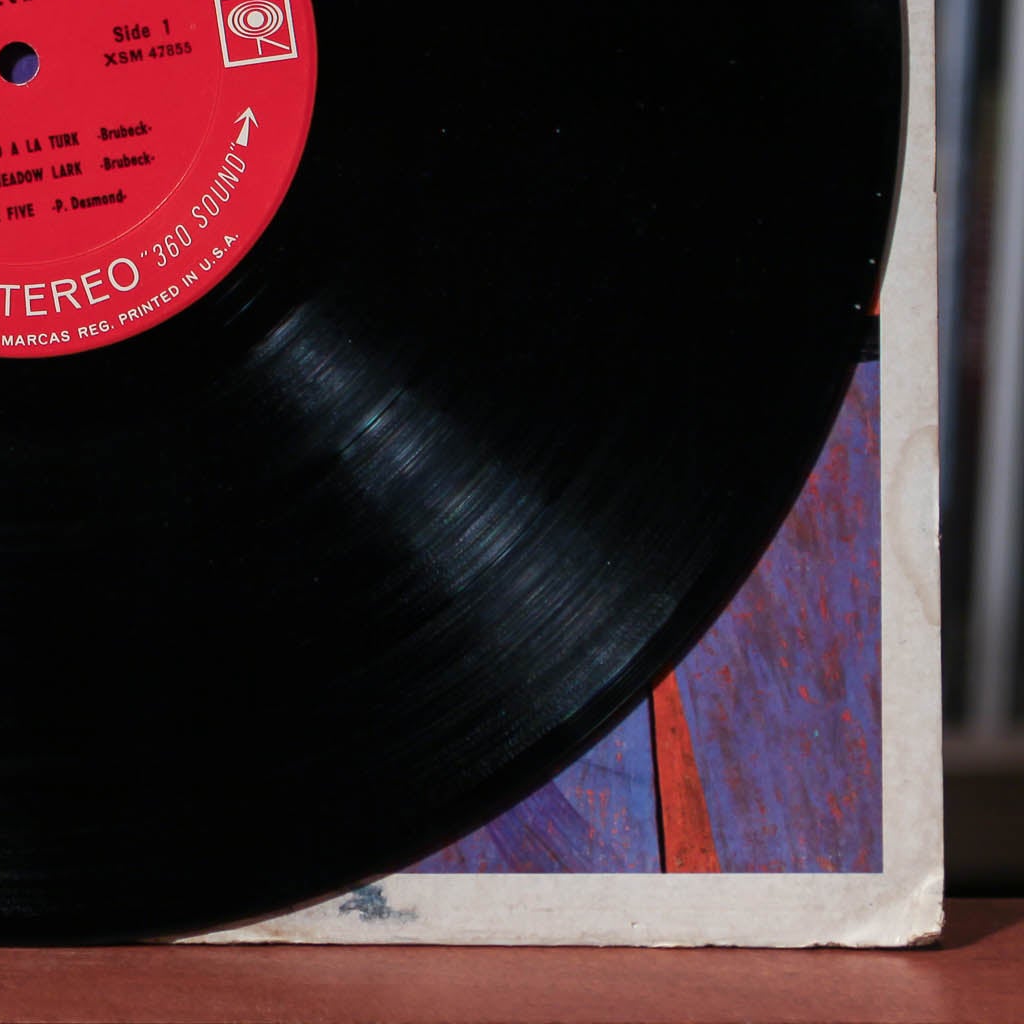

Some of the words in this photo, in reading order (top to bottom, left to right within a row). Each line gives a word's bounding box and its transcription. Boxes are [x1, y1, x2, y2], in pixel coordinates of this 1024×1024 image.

[112, 24, 150, 43] Side
[161, 18, 171, 35] 1
[104, 49, 143, 67] XSM
[10, 141, 19, 156] A
[25, 138, 42, 153] LA
[48, 132, 79, 148] TURK
[51, 162, 82, 179] LARK
[6, 203, 34, 219] FIVE
[1, 330, 71, 347] MARCAS
[77, 319, 115, 339] REG.
[118, 285, 180, 326] PRINTED
[181, 269, 199, 288] IN
[199, 232, 239, 272] U.S.A.
